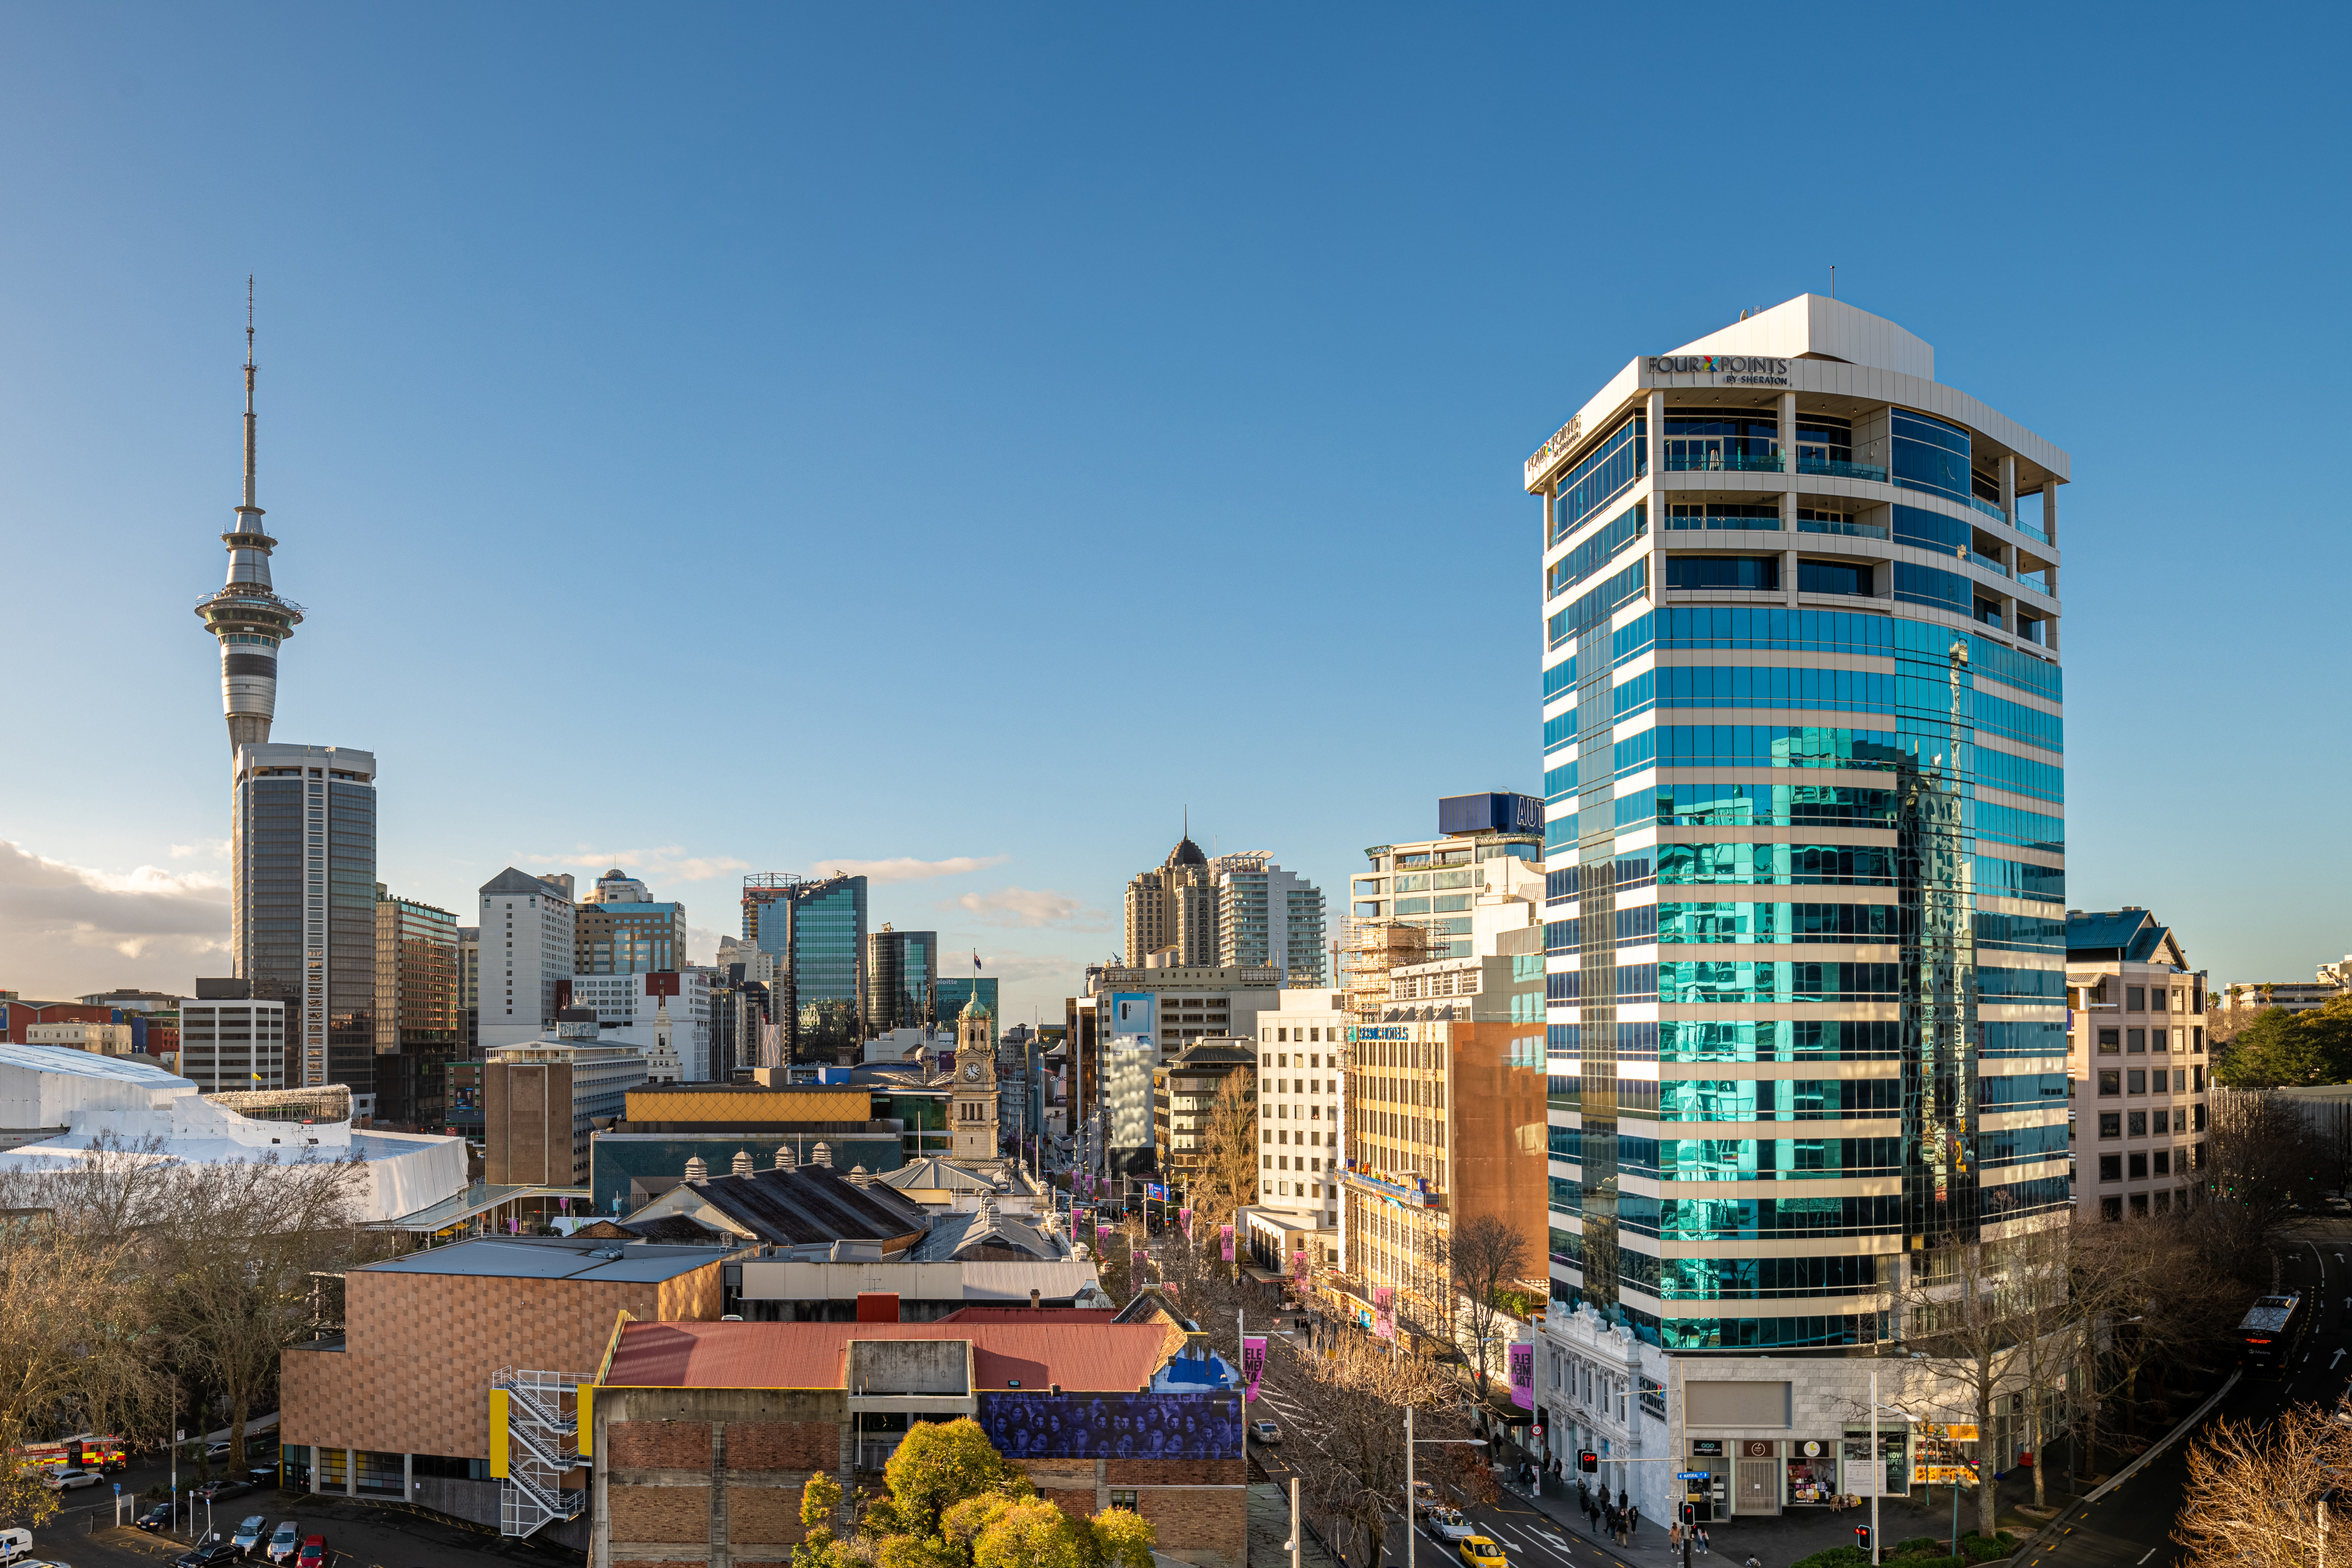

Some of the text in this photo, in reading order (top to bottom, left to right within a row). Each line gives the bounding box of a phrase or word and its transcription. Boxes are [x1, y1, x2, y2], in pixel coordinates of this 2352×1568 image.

[1648, 356, 1788, 374] FOUR POINTS
[1741, 375, 1788, 385] SHERATON
[1528, 414, 1578, 472] FOUR POINTS
[1517, 796, 1545, 829] AUT
[1359, 1027, 1409, 1040] SCENIC HOTELS
[1245, 1348, 1262, 1360] ELE
[1639, 1376, 1658, 1396] FOUR
[1639, 1390, 1665, 1412] POINTS
